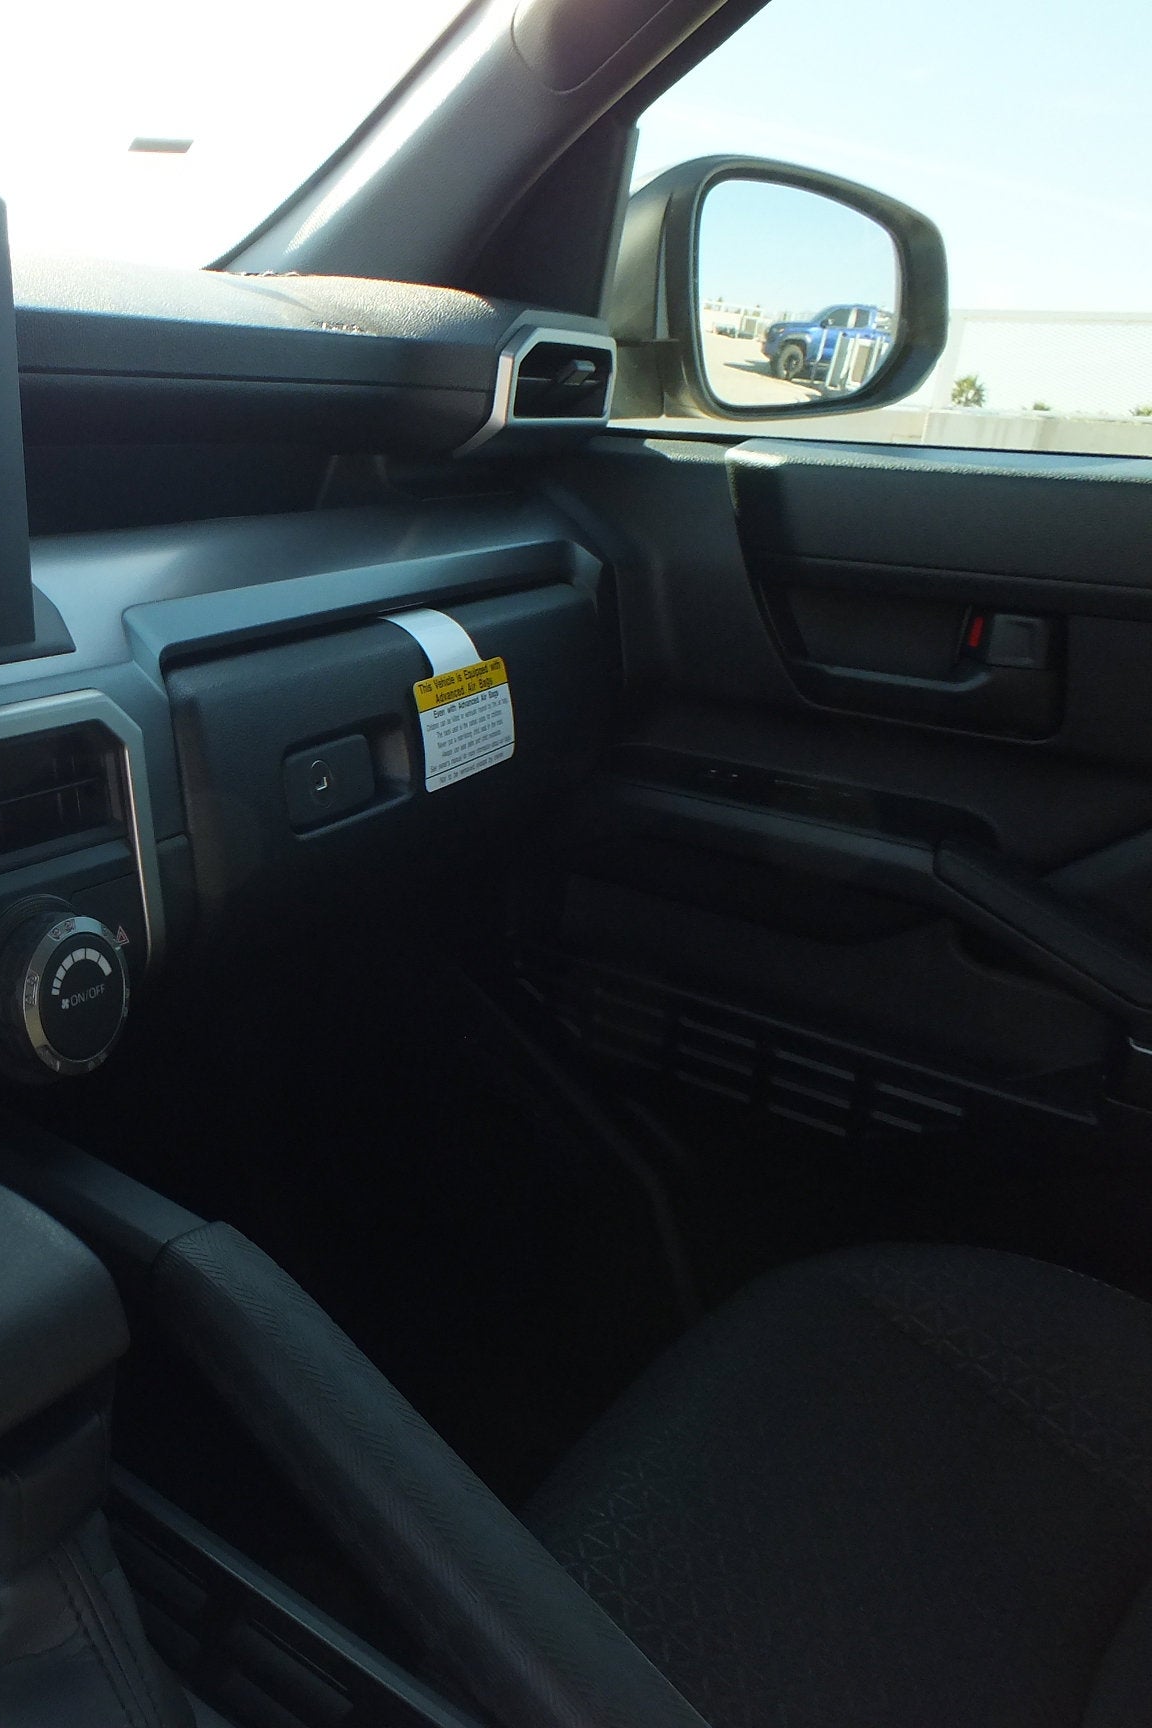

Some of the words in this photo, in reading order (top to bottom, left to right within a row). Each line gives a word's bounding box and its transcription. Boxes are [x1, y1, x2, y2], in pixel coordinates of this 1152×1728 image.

[418, 683, 433, 694] This
[433, 675, 455, 689] Vehicle
[455, 673, 463, 682] is
[463, 666, 489, 680] Equipped
[435, 687, 465, 704] Advanced
[467, 683, 476, 691] Air
[478, 677, 494, 689] Bags
[433, 708, 445, 719] Even
[458, 696, 479, 709] Advanced
[70, 983, 105, 1007] ON/OFF
